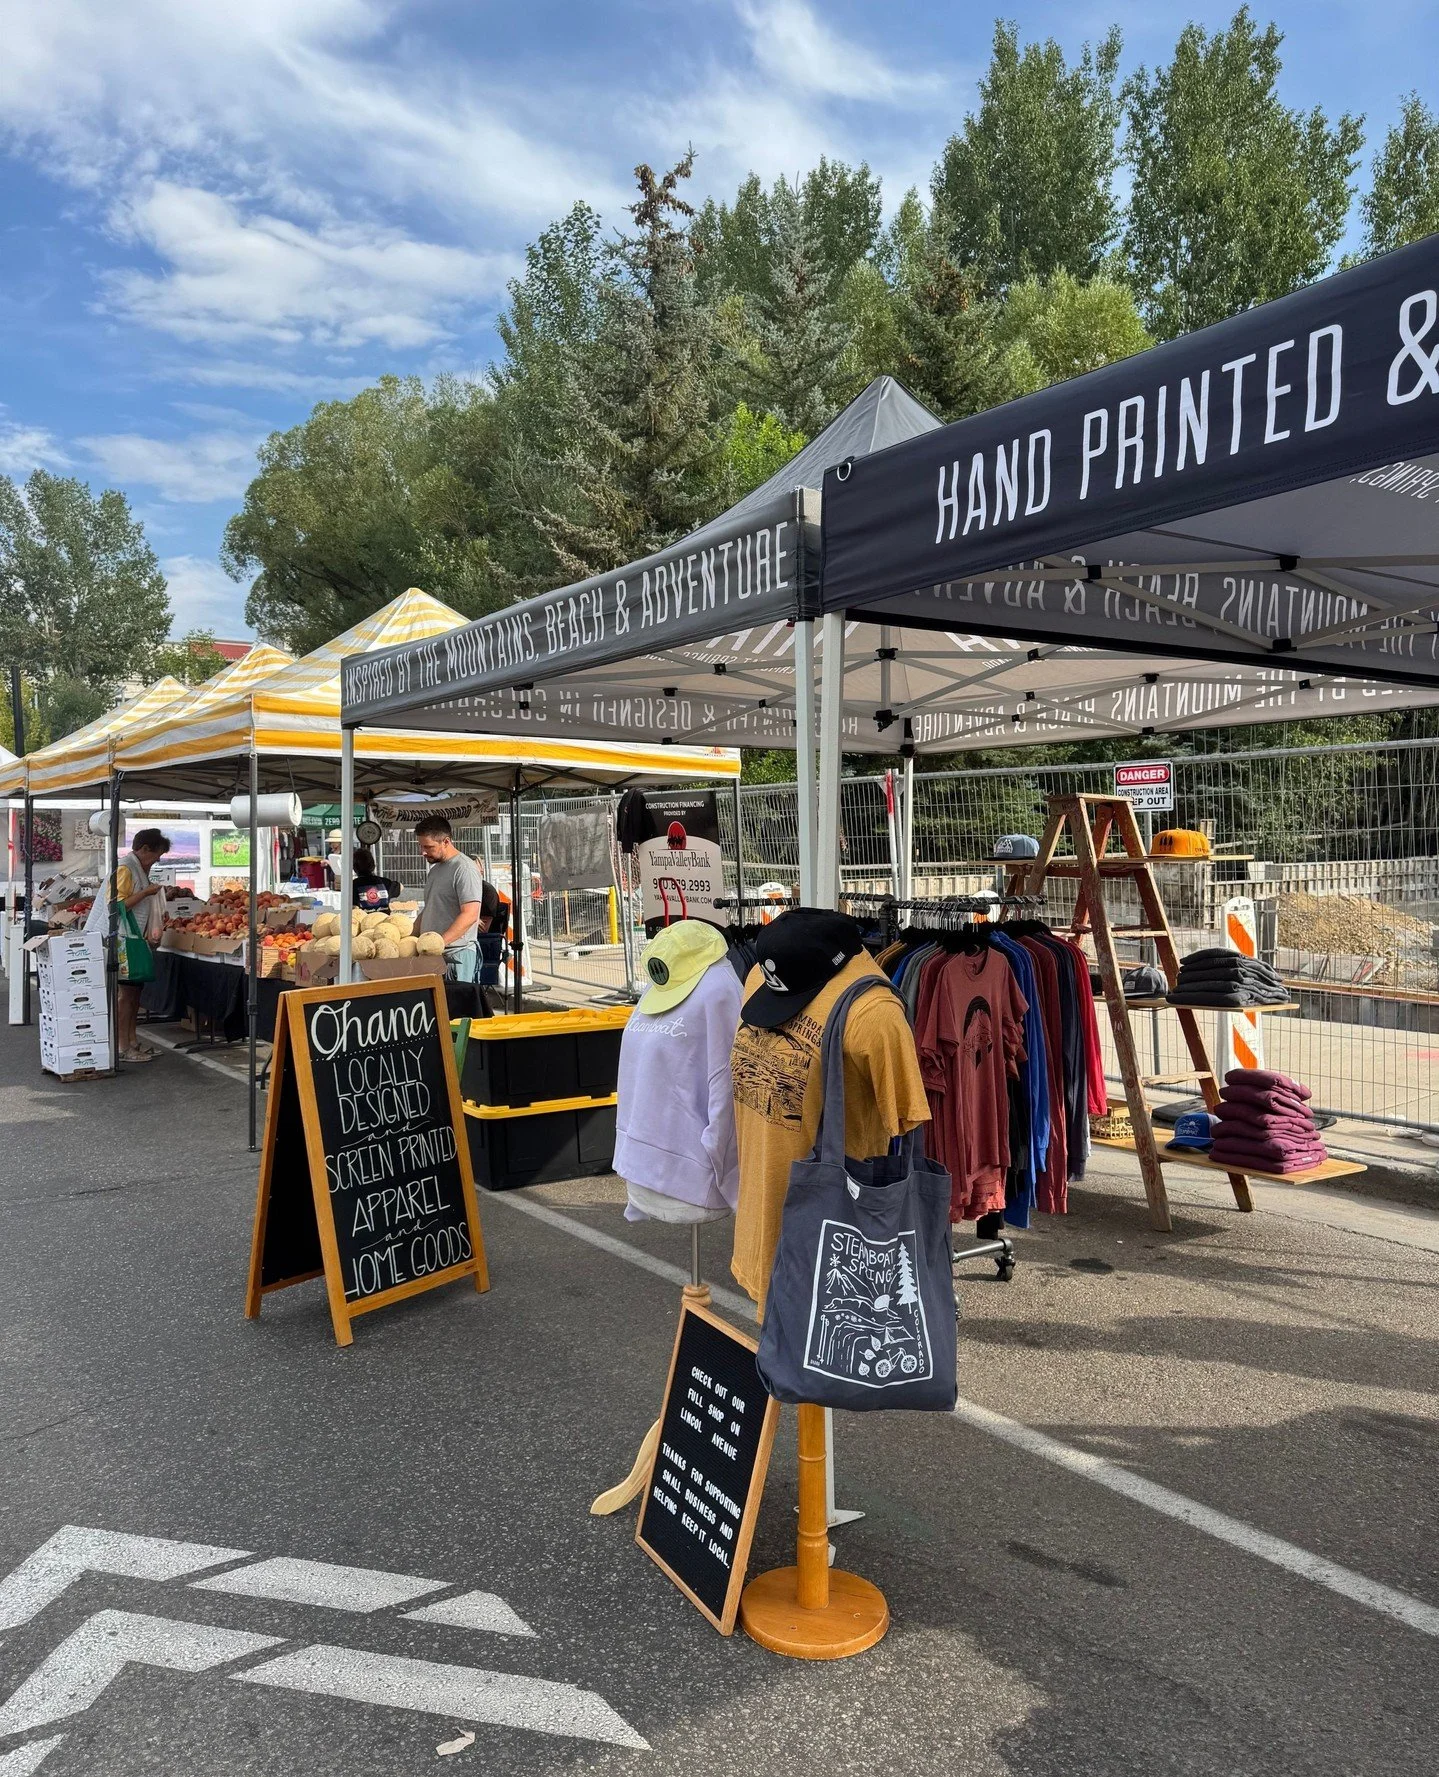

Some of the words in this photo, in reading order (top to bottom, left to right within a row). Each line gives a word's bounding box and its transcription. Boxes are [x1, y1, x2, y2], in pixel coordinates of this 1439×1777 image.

[935, 429, 1051, 544] HAND
[1079, 324, 1343, 500] PRINTED
[1387, 290, 1439, 406] &
[345, 657, 393, 706] INSPIRED
[396, 651, 411, 693] BY
[416, 642, 441, 689] THE
[445, 614, 540, 682] MOUNTAINS,
[544, 587, 605, 655] BEACH
[615, 579, 630, 636] &
[641, 521, 789, 629] ADVENTURE
[1118, 787, 1154, 796] CONSTRUCTION
[1155, 786, 1168, 795] AREA
[1120, 769, 1166, 781] DANGER
[1147, 797, 1166, 805] OUT
[645, 801, 679, 810] CONSTRUCTION
[679, 800, 704, 808] FINANCING
[311, 1000, 436, 1060] Ohana
[788, 1021, 822, 1047] SPRINGS
[333, 1046, 425, 1098] LOCALLY
[338, 1081, 430, 1134] DESIGNED
[325, 1141, 394, 1193] SCREEN
[398, 1126, 458, 1173] PRINTED
[352, 1175, 450, 1238] APPAREL
[411, 1222, 472, 1276] GOODS
[831, 1233, 896, 1267] STEAMBOAT
[914, 1309, 925, 1374] COLORADO
[687, 1388, 703, 1408] FULL
[707, 1403, 725, 1422] SHOP
[730, 1421, 741, 1437] ON
[691, 1366, 713, 1389] CHECK
[715, 1383, 728, 1399] OUT
[732, 1396, 745, 1414] OUR
[680, 1407, 702, 1433] LINCOL
[711, 1432, 738, 1461] AVENUE
[662, 1442, 687, 1471] THANKS
[690, 1467, 703, 1486] FOR
[704, 1480, 741, 1520] SUPPORTING
[662, 1469, 681, 1493] SMALL
[685, 1488, 716, 1525] BUSINESS
[719, 1521, 733, 1540] AND
[653, 1486, 678, 1515] HELPING
[681, 1512, 699, 1535] KEEP
[698, 1528, 707, 1543] IT
[708, 1538, 730, 1569] LOCAL.
